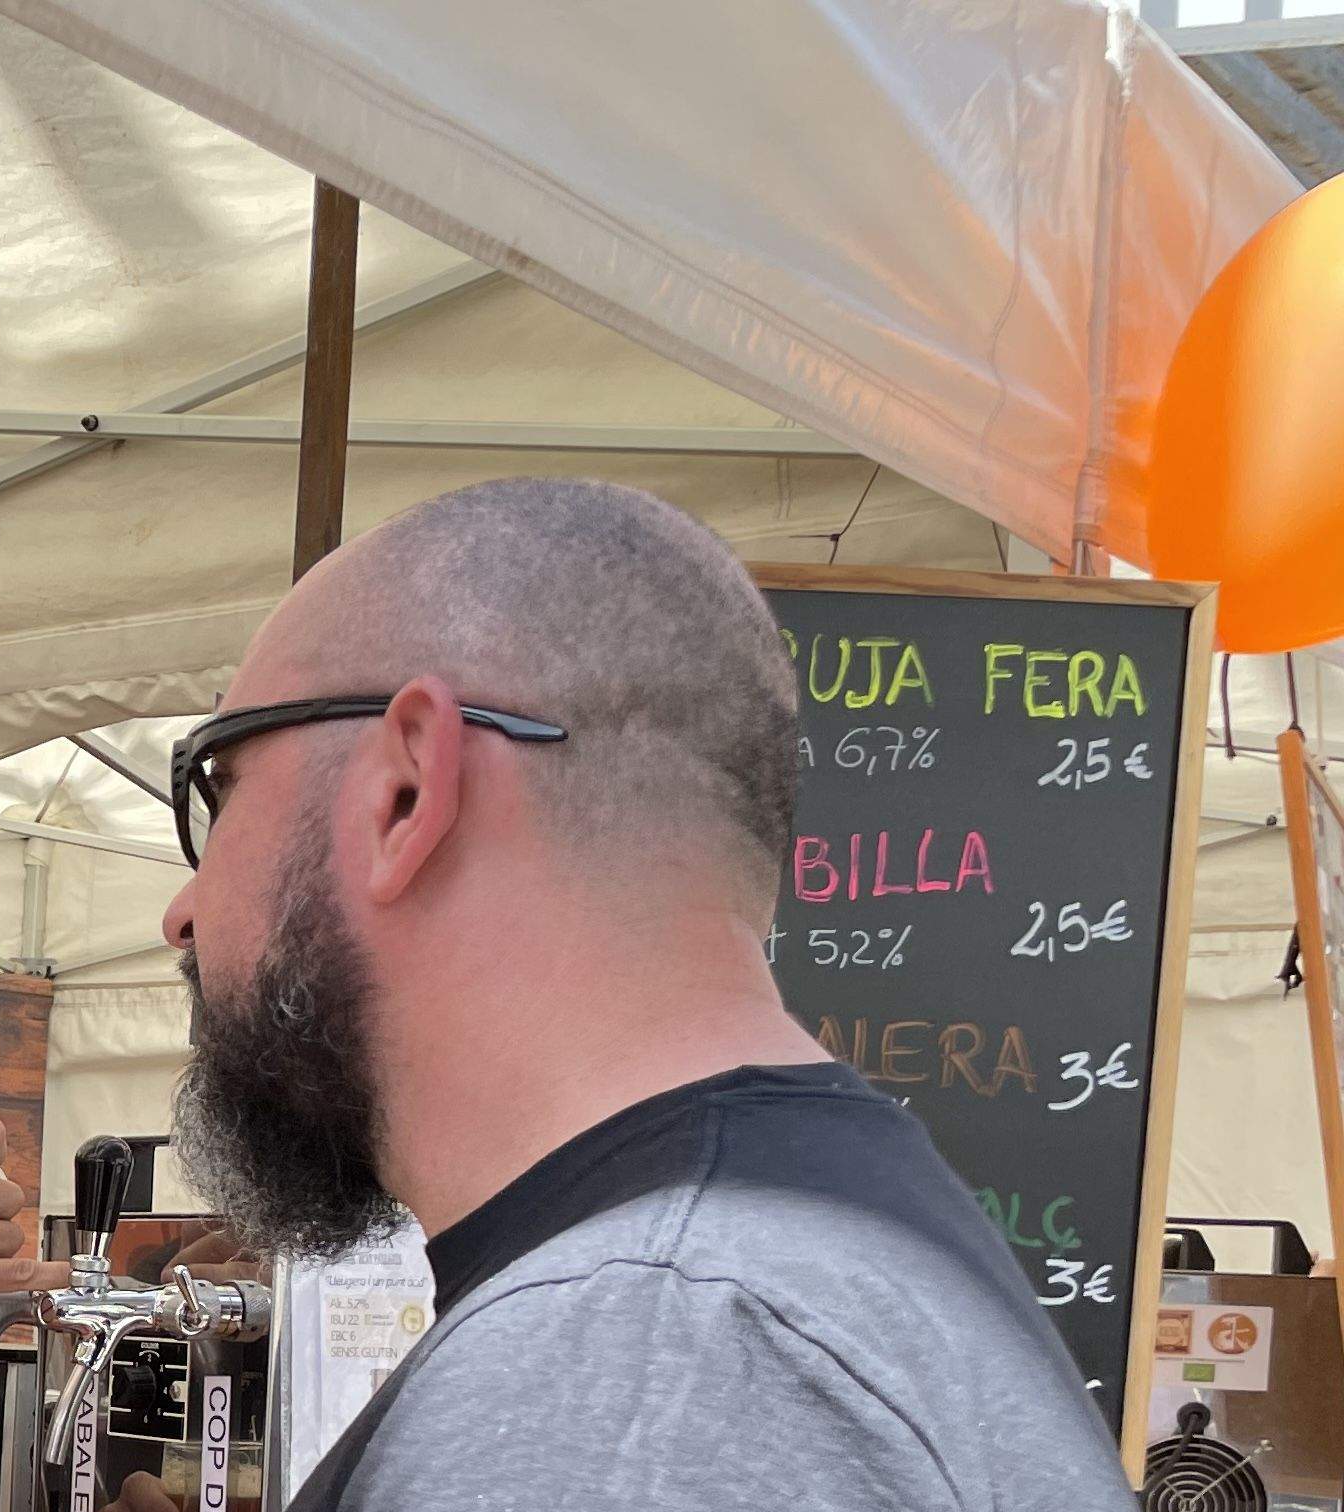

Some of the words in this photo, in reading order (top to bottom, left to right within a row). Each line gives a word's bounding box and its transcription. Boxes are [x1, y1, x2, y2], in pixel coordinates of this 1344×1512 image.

[983, 642, 1148, 718] FERA
[834, 726, 942, 776] 6,7%
[808, 924, 913, 970] 5,2%
[1047, 1042, 1140, 1111] 3€
[1036, 1258, 1117, 1305] 3€
[207, 1385, 229, 1471] COP
